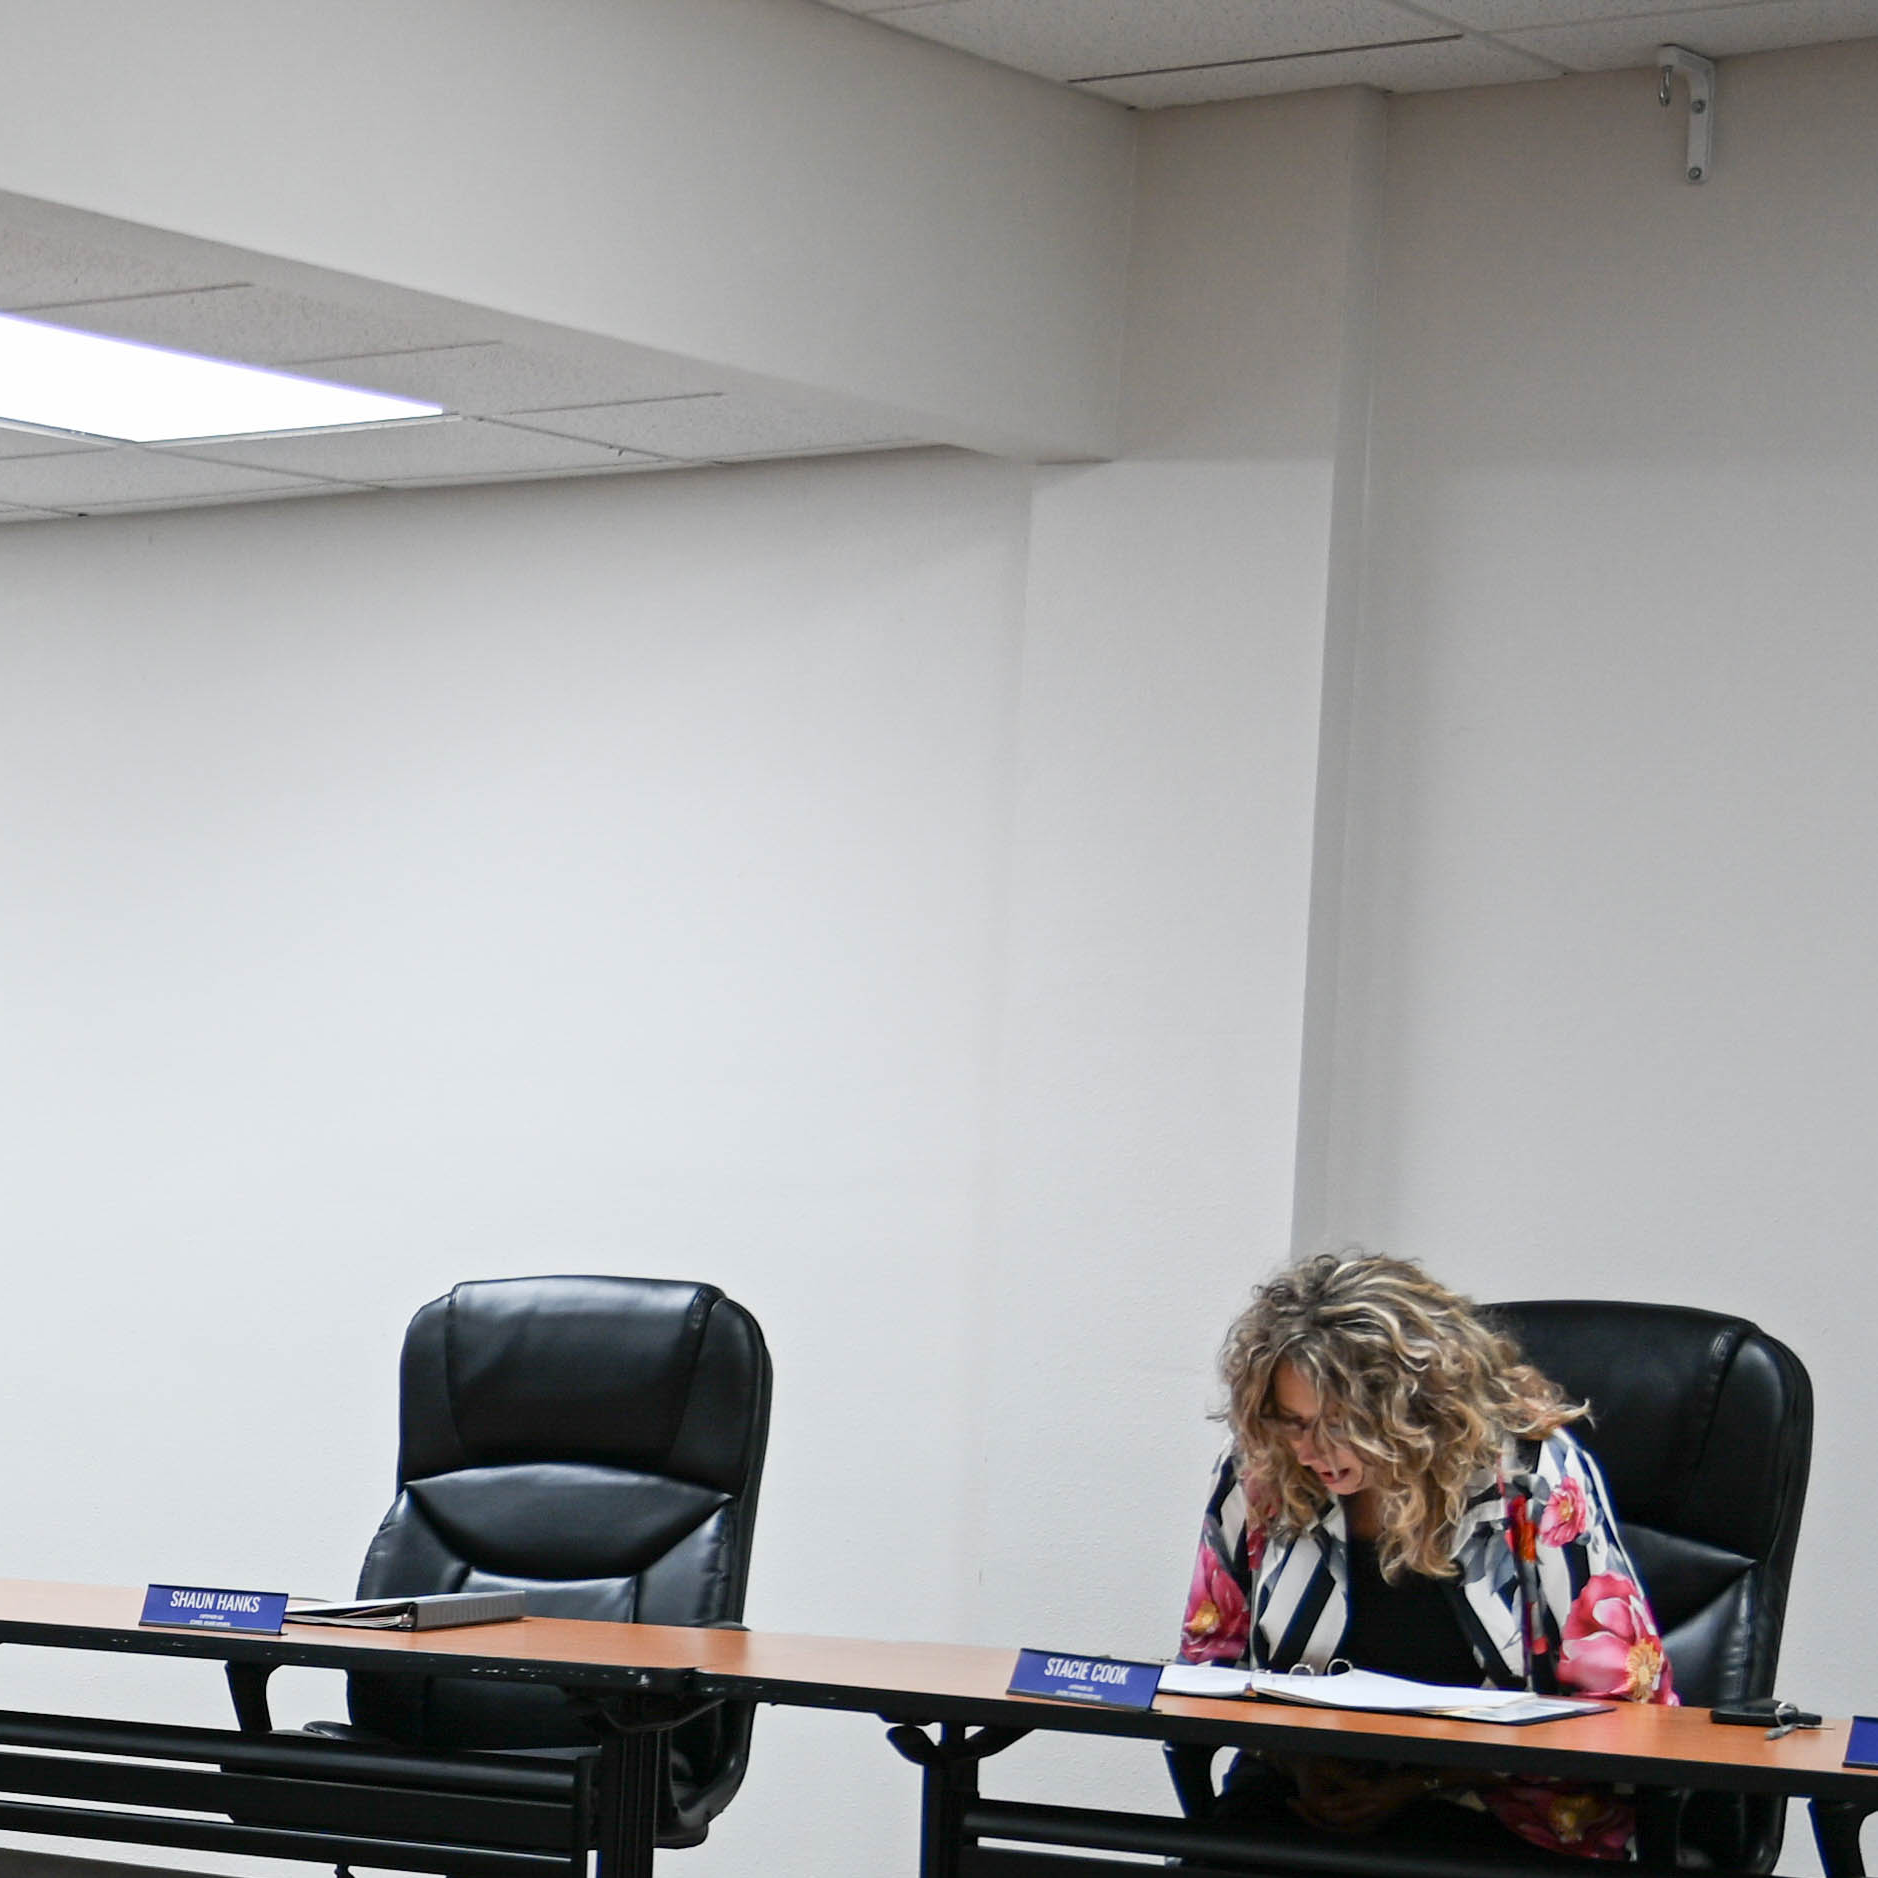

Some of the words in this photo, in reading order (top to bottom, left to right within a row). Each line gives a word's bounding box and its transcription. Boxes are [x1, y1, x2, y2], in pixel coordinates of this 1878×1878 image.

[170, 1590, 215, 1609] SHAUN
[216, 1593, 261, 1613] HANKS
[1044, 1657, 1091, 1681] STACIE
[1090, 1663, 1130, 1685] COOK
